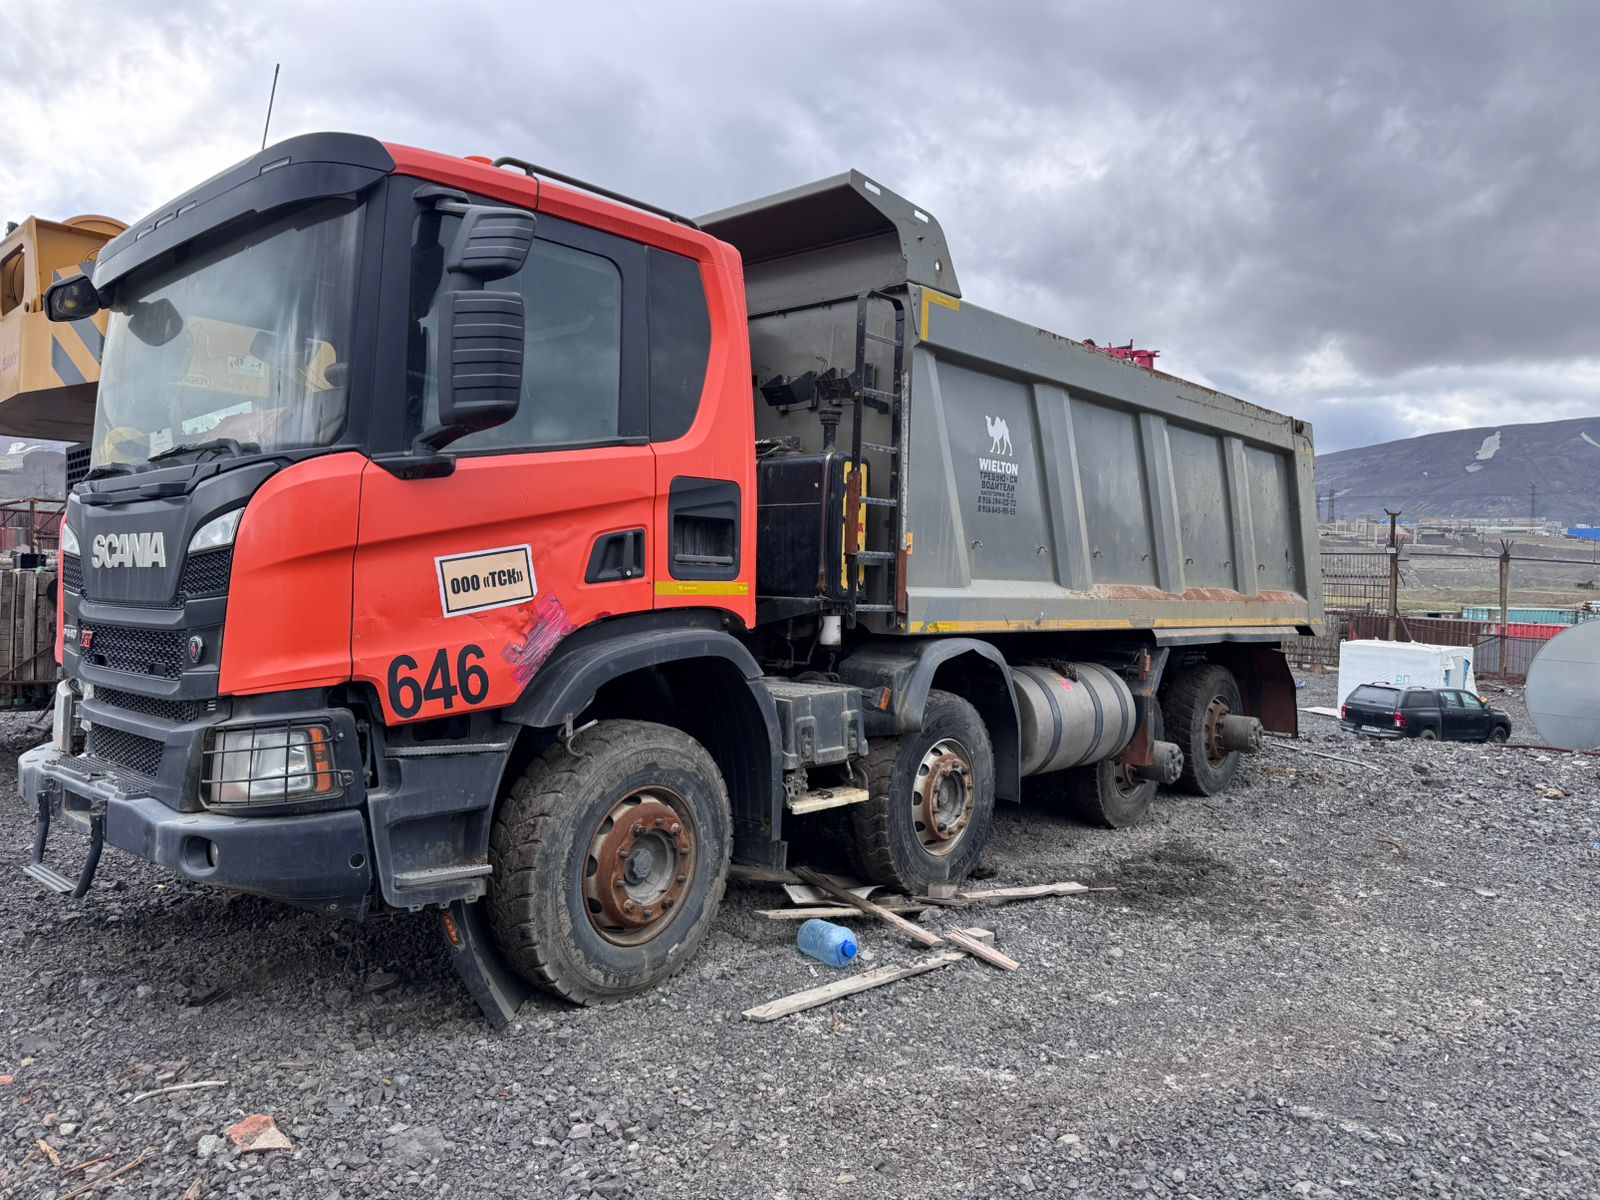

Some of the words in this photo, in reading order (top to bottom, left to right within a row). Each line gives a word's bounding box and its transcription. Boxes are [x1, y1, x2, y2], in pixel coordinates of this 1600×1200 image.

[979, 457, 1018, 475] WIELTON
[981, 480, 1015, 492] ВОДИТЕЛИ
[91, 532, 166, 568] SCANIA
[451, 575, 480, 594] ООО
[483, 568, 523, 588] «ТСК»
[388, 644, 489, 719] 646
